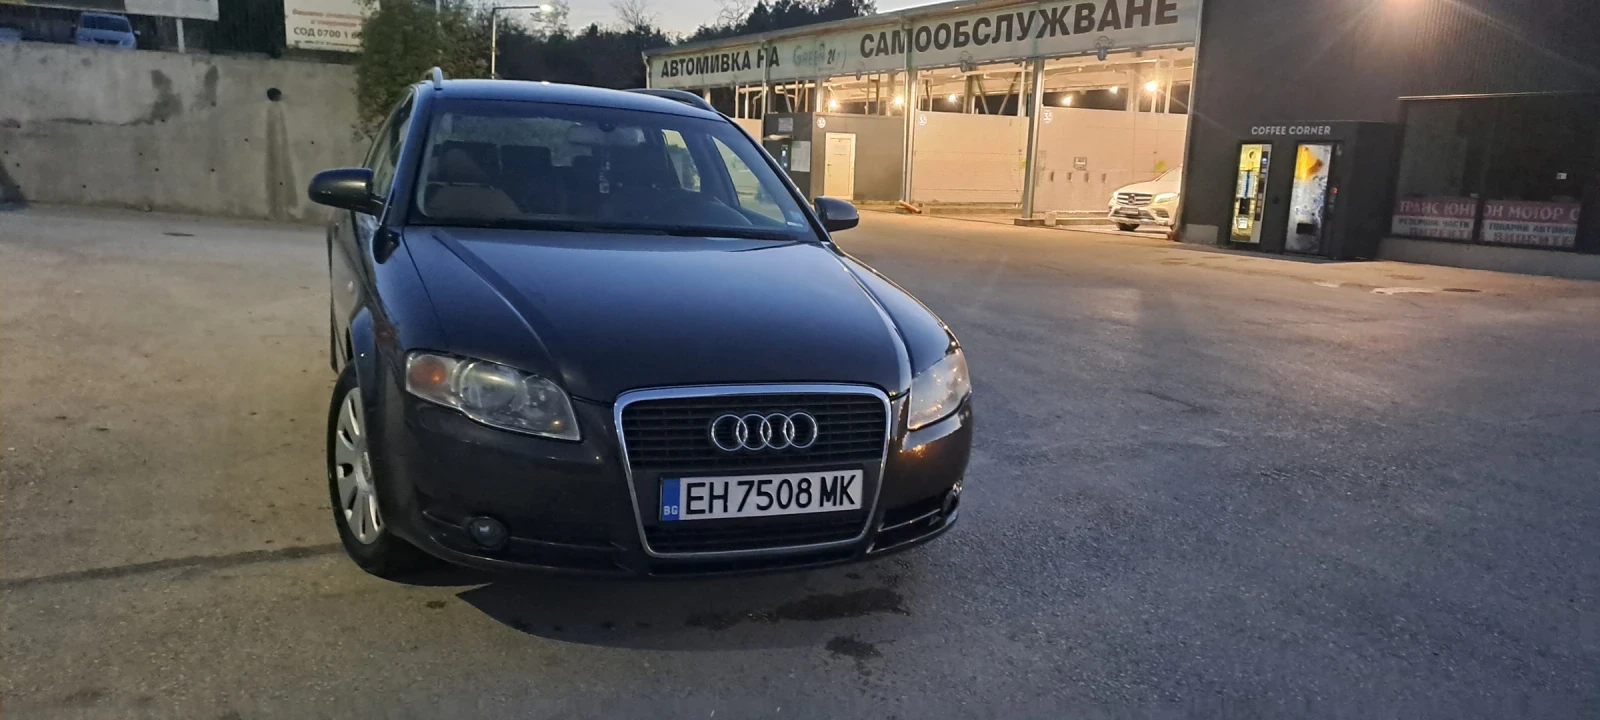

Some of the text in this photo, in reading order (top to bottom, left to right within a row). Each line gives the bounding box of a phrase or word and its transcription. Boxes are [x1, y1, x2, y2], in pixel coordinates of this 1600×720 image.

[293, 26, 316, 37] СОД
[317, 28, 341, 38] 0700
[859, 0, 1179, 58] САМООБСЛУЖВАНЕ
[661, 46, 780, 78] АВТОМИВКА НА
[1251, 125, 1331, 135] COFFEE CORNER
[1508, 206, 1564, 220] МОТОР
[736, 477, 812, 511] 7508
[663, 506, 678, 515] BG
